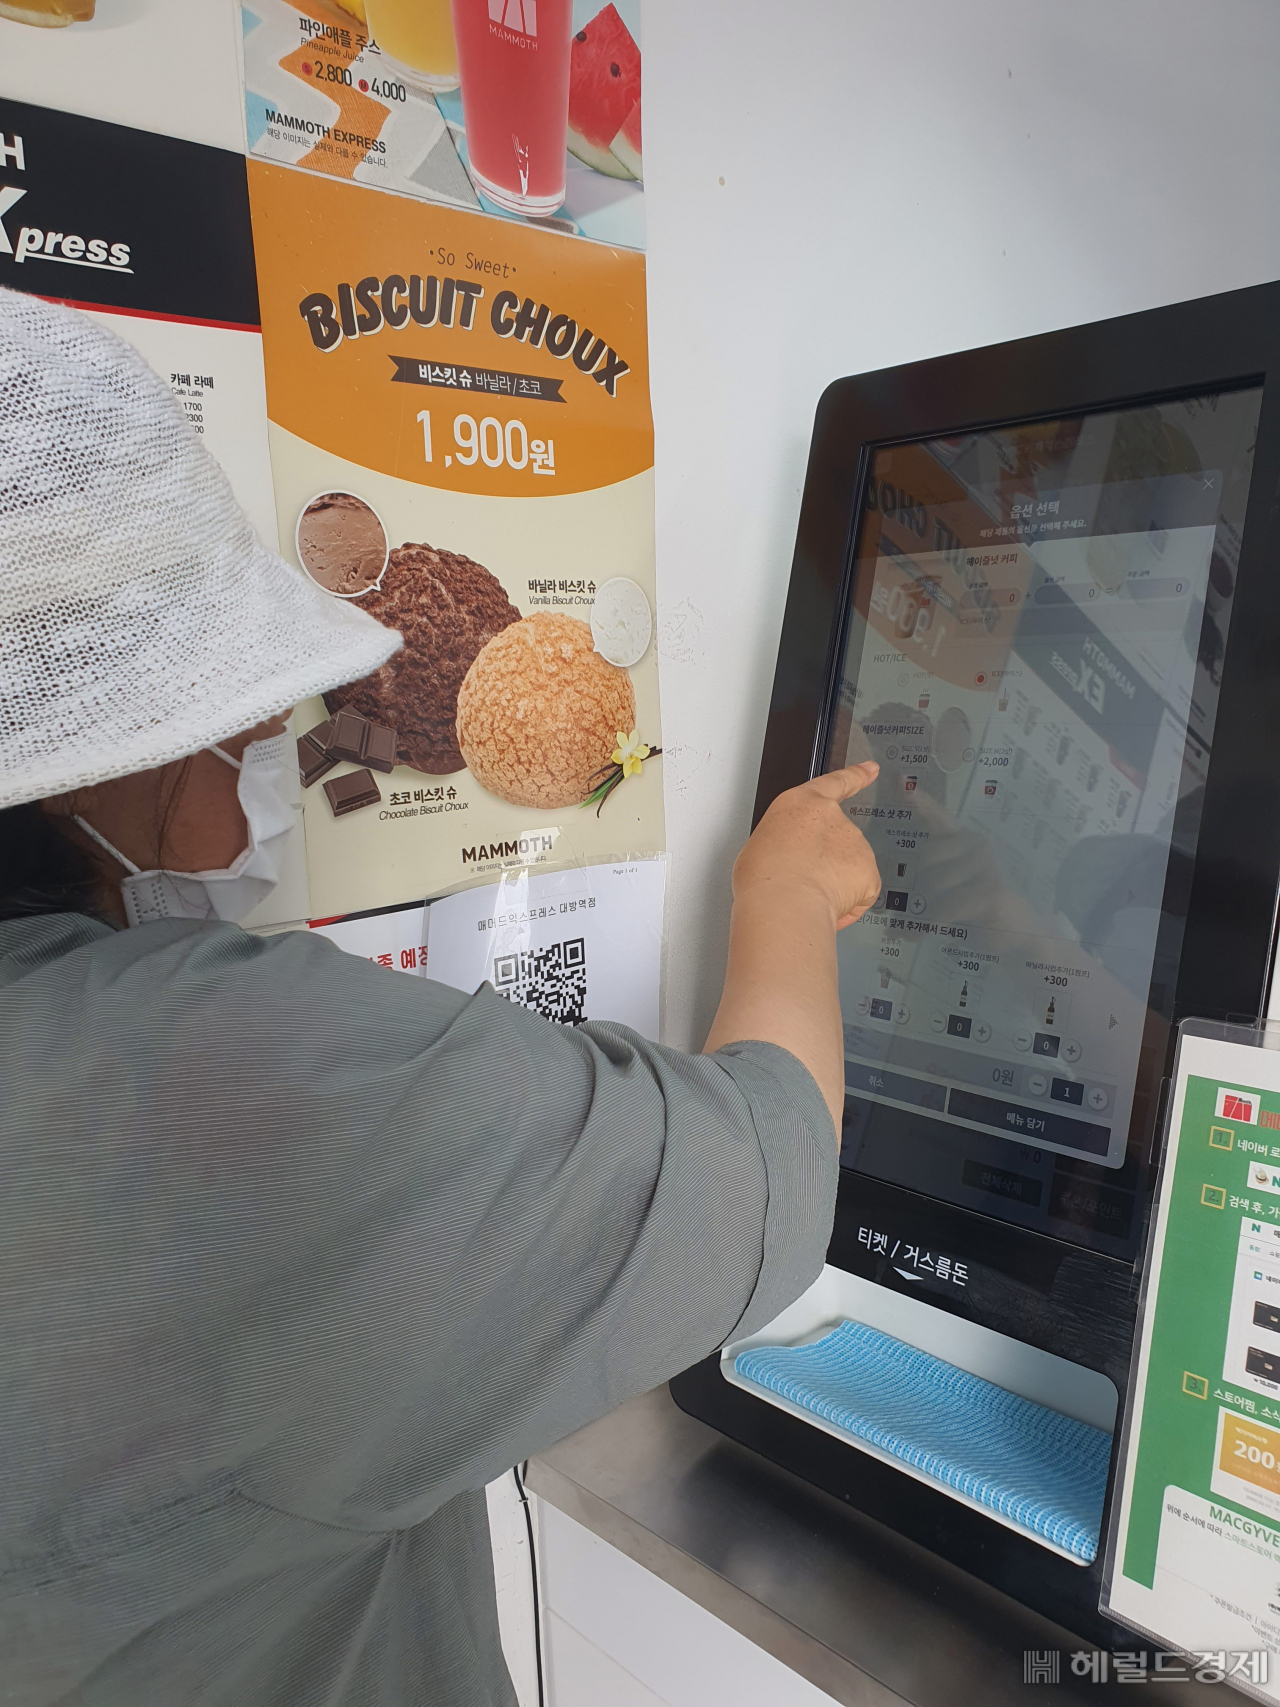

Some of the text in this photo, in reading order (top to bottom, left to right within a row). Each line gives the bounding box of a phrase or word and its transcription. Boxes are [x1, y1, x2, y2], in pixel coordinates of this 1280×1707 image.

[299, 17, 382, 55] 파인애플 주스
[489, 23, 538, 51] MAMMOTH
[301, 37, 365, 63] Pineapple Juice
[315, 61, 352, 87] 2,800
[371, 77, 406, 102] 4,000
[265, 108, 387, 154] MAMMOTH EXPRESS
[267, 127, 281, 140] 해당
[283, 131, 311, 148] 이미지는
[335, 146, 349, 158] 다를
[351, 151, 359, 160] 수
[299, 274, 632, 398] BISCUIT CHOUX
[170, 373, 214, 389] 카페 라떼
[183, 402, 203, 411] 1700
[416, 409, 556, 476] 1,900원
[1010, 500, 1060, 519] 옵션 선택
[966, 553, 1018, 567] 헤이즐넛 커피
[528, 579, 597, 594] 바닐라 비스킷 슈
[1088, 588, 1095, 598] 0
[1175, 583, 1183, 593] 0
[528, 595, 596, 605] Vanilla Biscuit Choux
[873, 653, 907, 664] HOT/ICE
[862, 725, 925, 735] 헤이즐넛커피SIZE
[900, 754, 928, 764] +1,500
[978, 757, 1009, 767] +2,000
[389, 785, 457, 806] 초코 비스킷 슈
[379, 801, 469, 821] Chocolate Biscuit Choux
[850, 806, 912, 821] 에스프레소 샷 추가
[461, 835, 553, 864] MAMMOTH
[895, 839, 916, 849] +300
[894, 897, 900, 906] 0
[477, 897, 596, 931] 매머드익스프레스 대방역점
[889, 918, 905, 930] 맞게
[906, 920, 938, 936] 추가해서
[939, 926, 968, 941] 드세요)
[879, 946, 900, 957] +300
[957, 960, 980, 972] +300
[1043, 975, 1068, 987] +300
[878, 1006, 884, 1014] 0
[956, 1023, 962, 1032] 0
[1043, 1040, 1050, 1051] 0
[868, 1075, 884, 1088] 취소
[992, 1067, 1015, 1087] 0원
[1063, 1087, 1070, 1098] 1
[1006, 1112, 1045, 1132] 메뉴 담기
[1237, 1139, 1268, 1157] 네이버
[1229, 1195, 1250, 1211] 검색
[1251, 1223, 1261, 1234] N
[857, 1226, 888, 1256] 티켓
[903, 1243, 969, 1287] 거스름돈
[1166, 1503, 1182, 1517] 위에
[1182, 1512, 1206, 1529] 순서에
[1206, 1522, 1223, 1537] 따라
[1224, 1531, 1272, 1560] 스마트스토어
